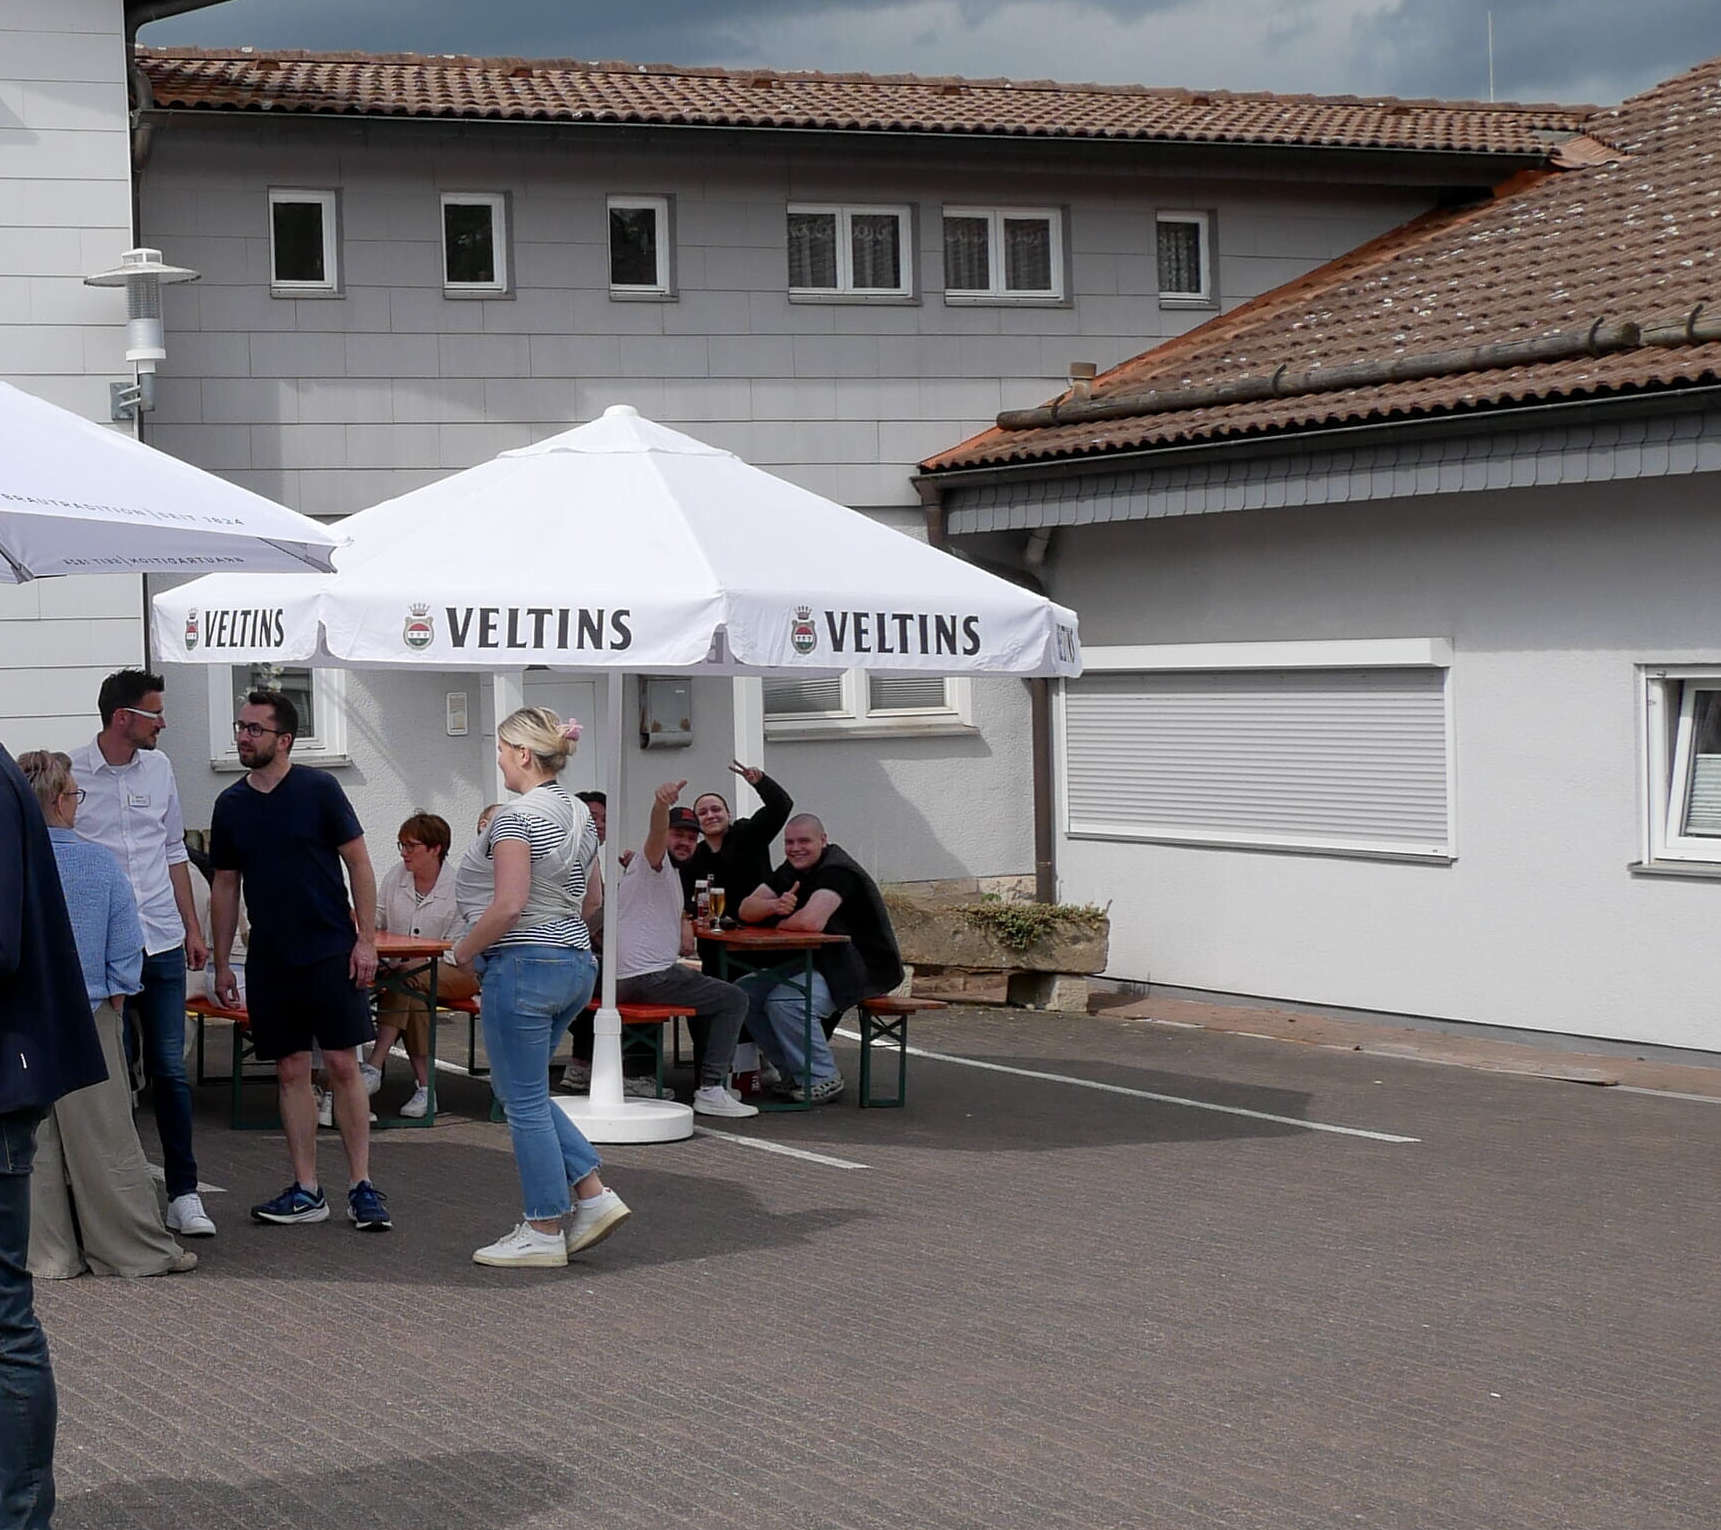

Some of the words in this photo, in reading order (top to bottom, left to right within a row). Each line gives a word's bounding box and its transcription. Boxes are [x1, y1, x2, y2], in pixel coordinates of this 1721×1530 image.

[204, 607, 285, 648] VELTINS
[445, 606, 633, 651] VELTINS
[824, 610, 981, 656] VELTINS
